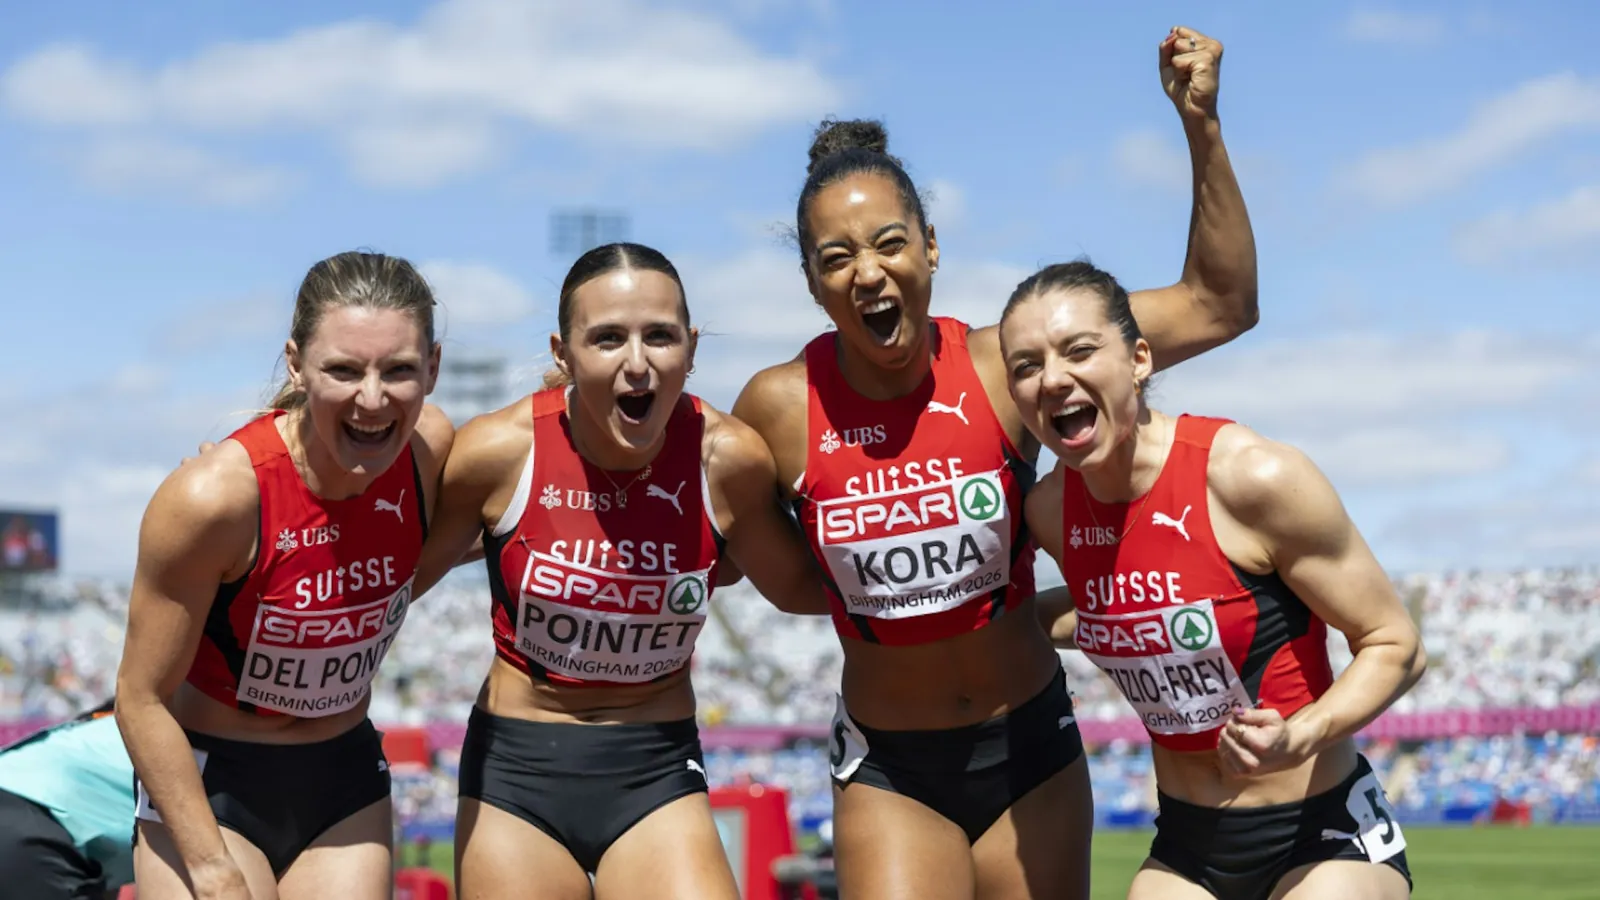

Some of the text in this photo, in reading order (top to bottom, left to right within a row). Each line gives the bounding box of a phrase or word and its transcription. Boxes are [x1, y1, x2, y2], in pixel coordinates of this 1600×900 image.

[843, 424, 887, 447] UBS
[566, 489, 611, 512] UBS
[826, 491, 954, 539] SPAR
[301, 524, 340, 547] UBS
[1085, 526, 1116, 546] UBS
[853, 533, 985, 587] KORA
[530, 565, 661, 610] SPAR
[848, 570, 1002, 610] BIRMINGHAM 2026
[262, 607, 385, 645] SPAR
[523, 602, 700, 654] POINTET
[1077, 620, 1168, 652] SPAR
[248, 652, 309, 689] DEL
[522, 637, 682, 677] BIRMINGHAM 2026
[246, 686, 364, 711] BIRMINGHAM
[1363, 787, 1395, 845] 5
